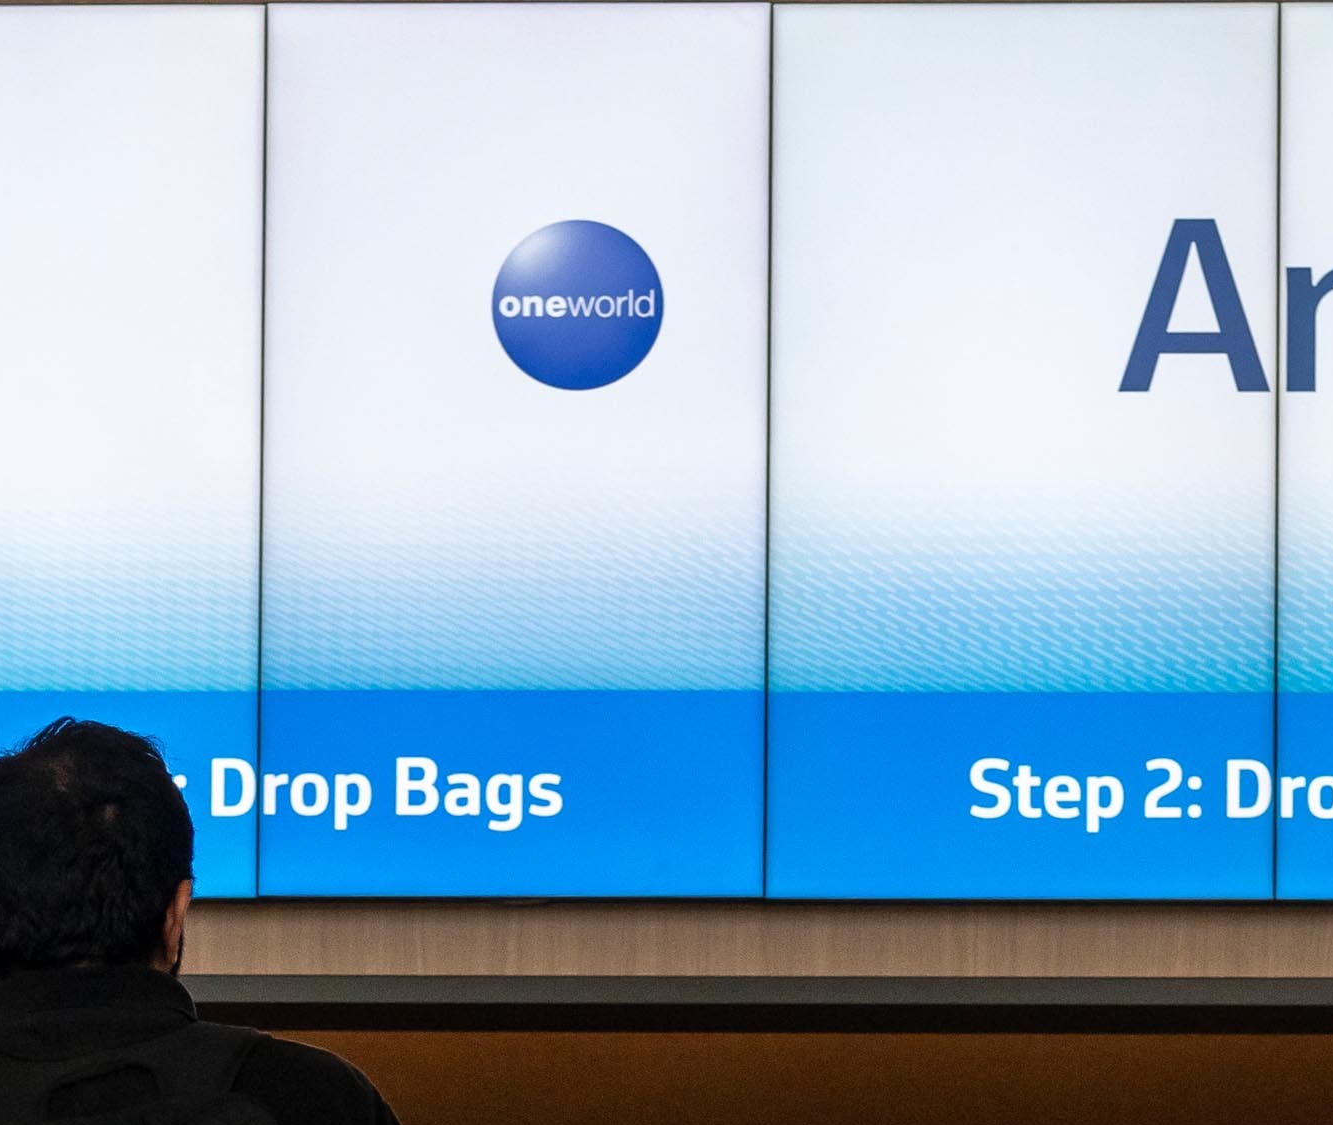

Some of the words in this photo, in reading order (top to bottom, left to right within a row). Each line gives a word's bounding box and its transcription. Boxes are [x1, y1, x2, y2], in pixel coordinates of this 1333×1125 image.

[499, 289, 656, 319] oneworld
[210, 757, 373, 831] Drop
[394, 756, 564, 833] Bags
[969, 757, 1126, 834] Step
[1143, 757, 1203, 820] 2:
